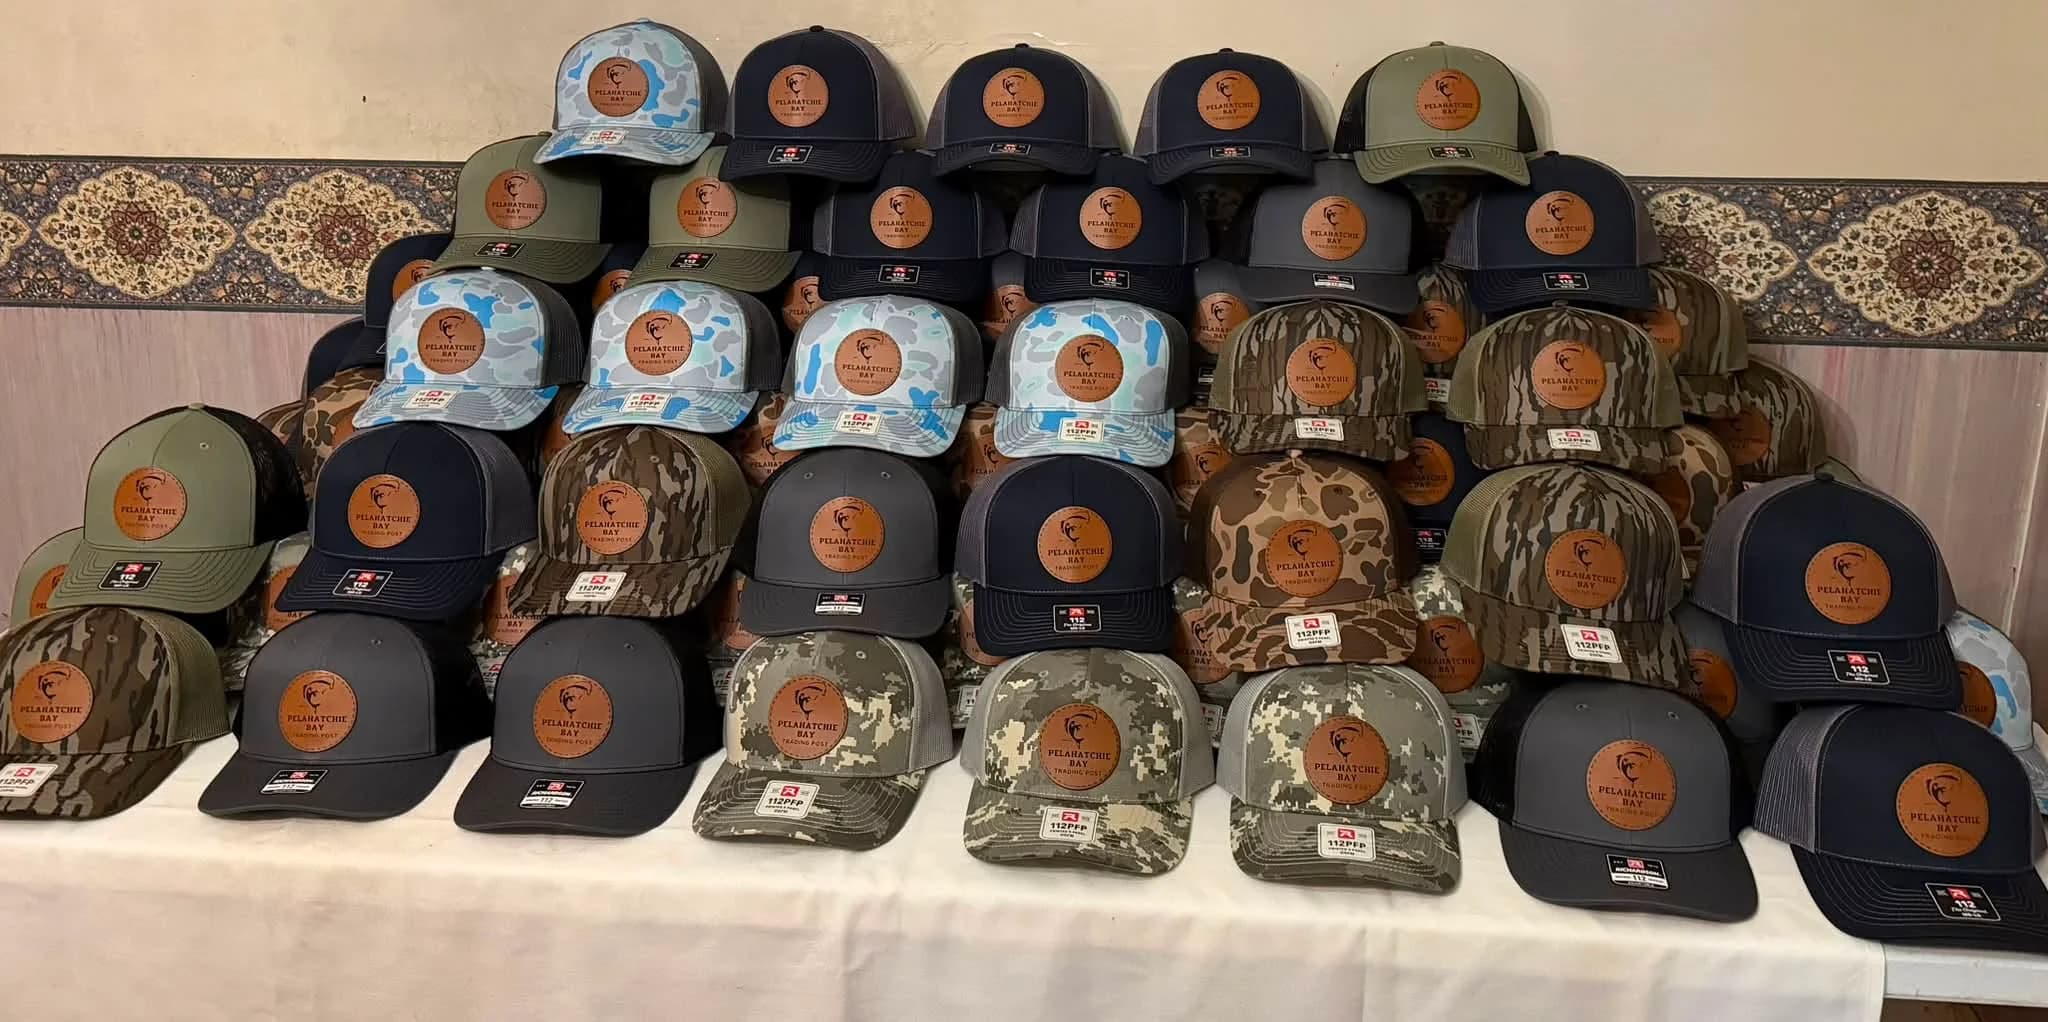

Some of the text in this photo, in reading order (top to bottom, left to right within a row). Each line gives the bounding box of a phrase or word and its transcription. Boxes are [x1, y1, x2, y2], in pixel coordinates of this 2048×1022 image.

[633, 345, 685, 353] PELAHATCHIE
[842, 364, 894, 374] PELAHATCHIE
[859, 371, 875, 379] BAY
[1063, 370, 1115, 379] PELAHATCHIE
[120, 506, 177, 516] PELAHATCHIE
[137, 514, 156, 522] BAY
[355, 513, 412, 523] PELAHATCHIE
[584, 521, 640, 529] PELAHATCHIE
[602, 528, 620, 536] BAY
[819, 537, 877, 546] PELAHATCHIE
[838, 545, 856, 553] BAY
[1047, 547, 1105, 556] PELAHATCHIE
[1067, 556, 1085, 564] BAY
[1276, 559, 1336, 571] PELAHATCHIE
[1297, 569, 1315, 578] BAY
[1555, 569, 1617, 585] PELAHATCHIE
[579, 584, 612, 592] 112PFP
[1576, 580, 1596, 590] BAY
[1817, 585, 1881, 596] PELAHATCHIE
[1840, 595, 1860, 604] BAY
[1296, 629, 1331, 639] 112PFP
[1574, 641, 1611, 652] 112PFP
[1850, 665, 1870, 674] 112
[20, 706, 82, 714] PELAHATCHIE
[39, 714, 59, 722] BAY
[287, 714, 348, 723] PELAHATCHIE
[305, 723, 325, 731] BAY
[542, 718, 603, 730] PELAHATCHIE
[777, 719, 838, 732] PELAHATCHIE
[559, 729, 580, 737] BAY
[796, 730, 816, 739] BAY
[782, 738, 810, 746] TRADING
[1048, 749, 1111, 761] PELAHATCHIE
[1069, 759, 1088, 768] BAY
[1054, 767, 1084, 776] TRADING
[1314, 762, 1381, 775] PELAHATCHIE
[1337, 773, 1357, 783] BAY
[1598, 785, 1667, 801] PELAHATCHIE
[768, 797, 804, 807] 112PFP
[1621, 798, 1643, 808] BAY
[1910, 812, 1981, 825] PELAHATCHIE
[1049, 822, 1088, 831] 112PFP
[1936, 824, 1959, 833] BAY
[1327, 839, 1367, 850] 112PFP
[1632, 874, 1647, 882] 112
[1954, 899, 1977, 909] 112
